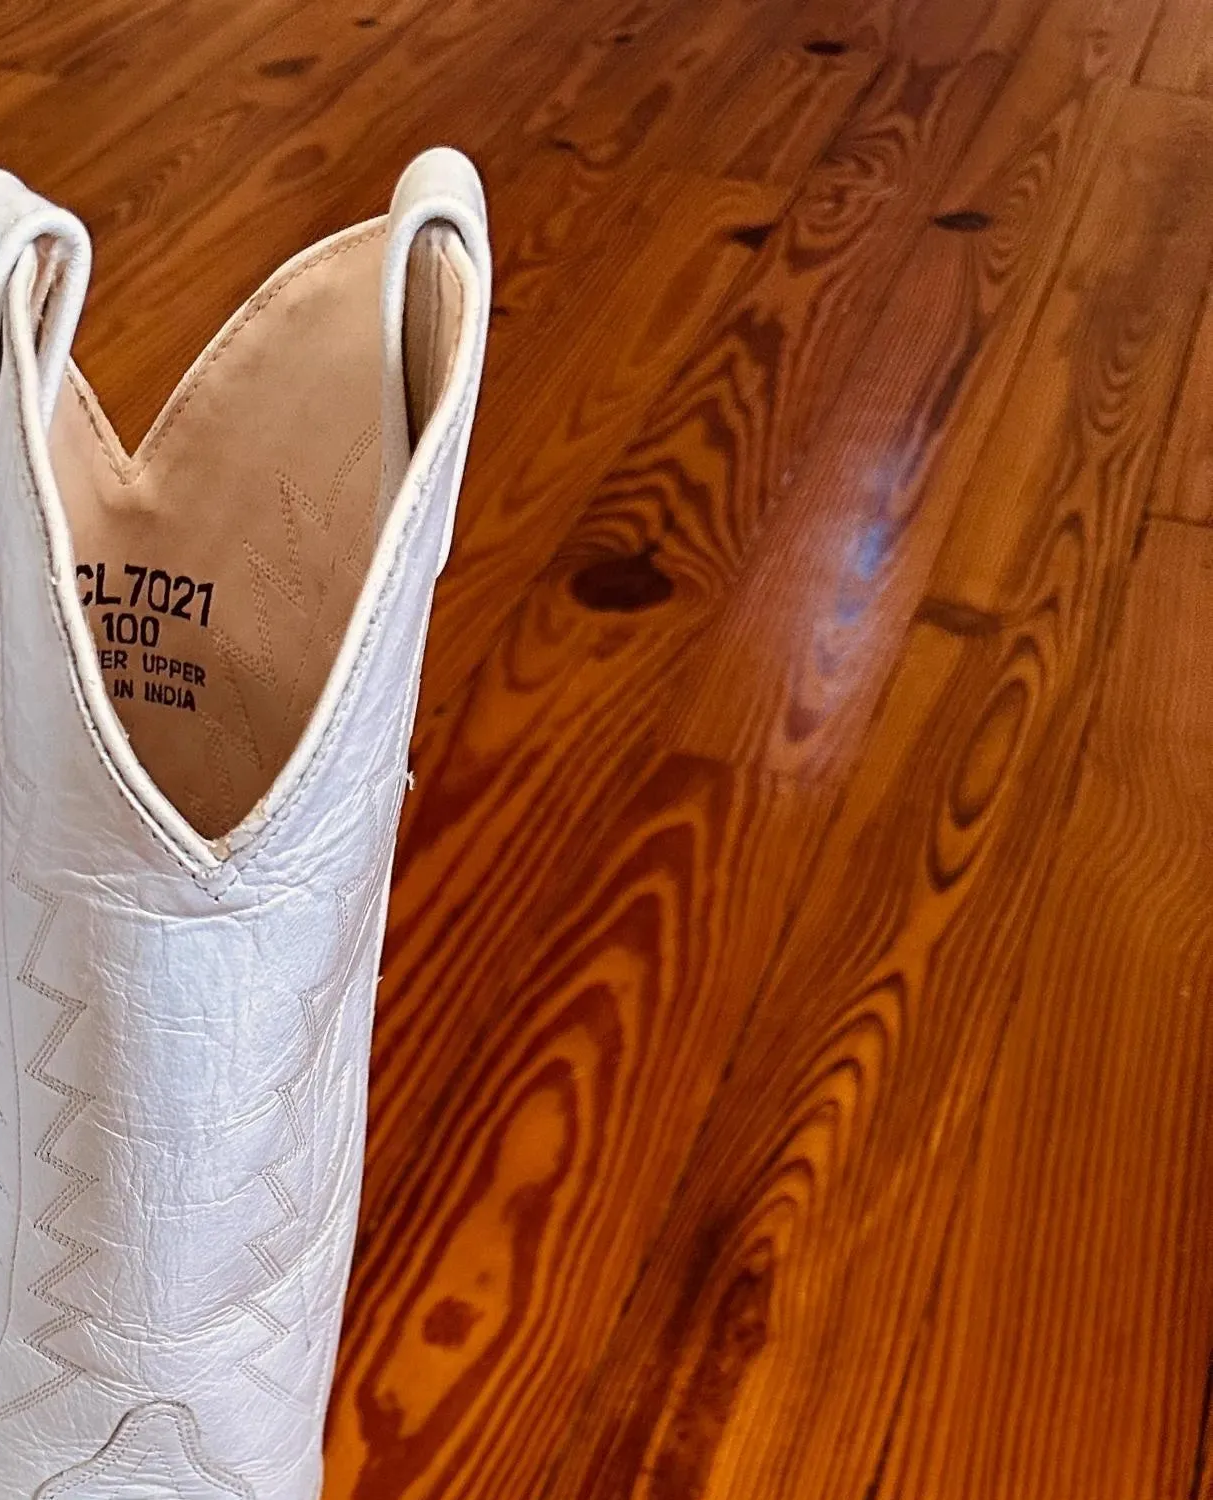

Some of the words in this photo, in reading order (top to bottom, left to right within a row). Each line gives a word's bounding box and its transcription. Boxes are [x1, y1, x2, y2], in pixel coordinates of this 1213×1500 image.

[76, 562, 214, 627] CL7021
[102, 612, 160, 648] 100
[142, 652, 206, 688] UPPER
[113, 679, 134, 699] IN
[144, 681, 196, 712] INDIA
